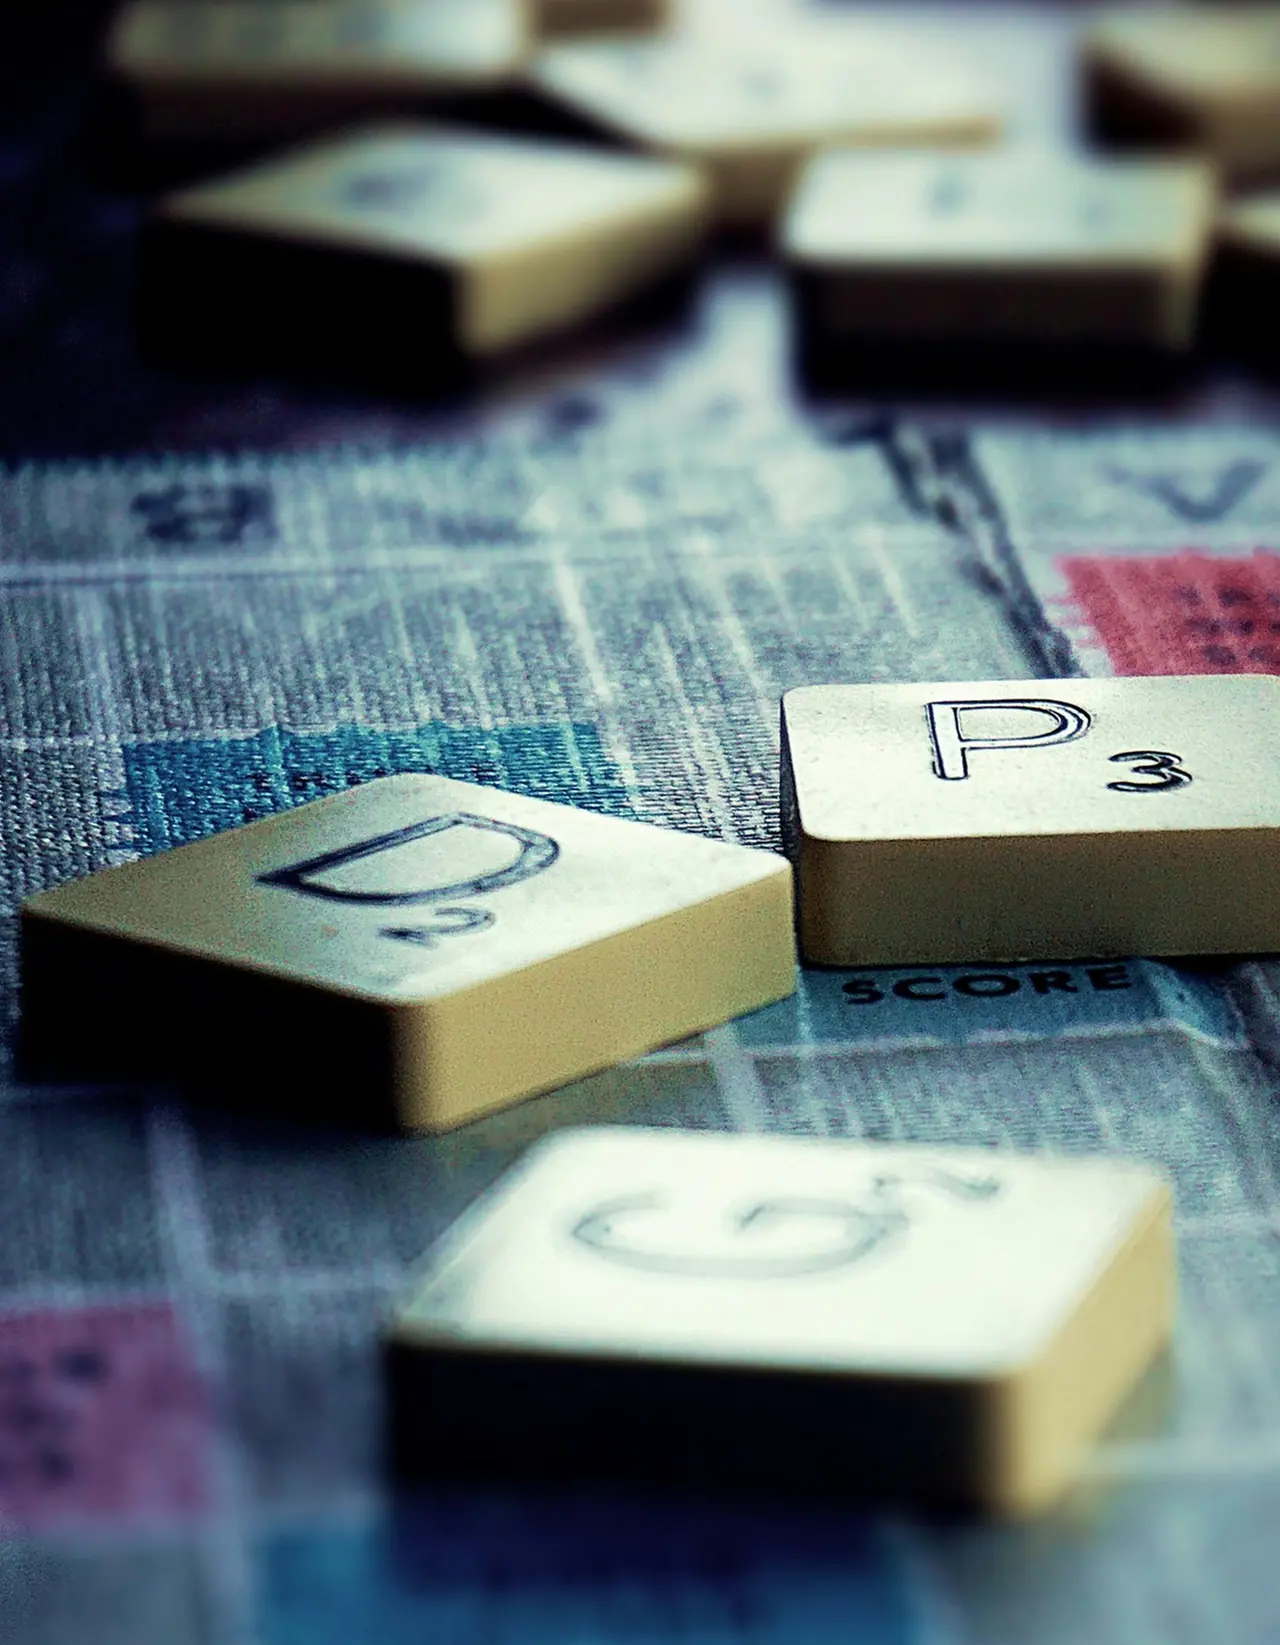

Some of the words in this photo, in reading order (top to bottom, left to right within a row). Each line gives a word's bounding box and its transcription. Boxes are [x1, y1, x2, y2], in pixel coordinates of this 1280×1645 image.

[923, 698, 1094, 781] P
[1105, 750, 1194, 792] 3
[253, 810, 561, 904] D
[378, 906, 497, 950] 2
[842, 963, 1134, 1005] SCORE
[570, 1186, 912, 1281] G
